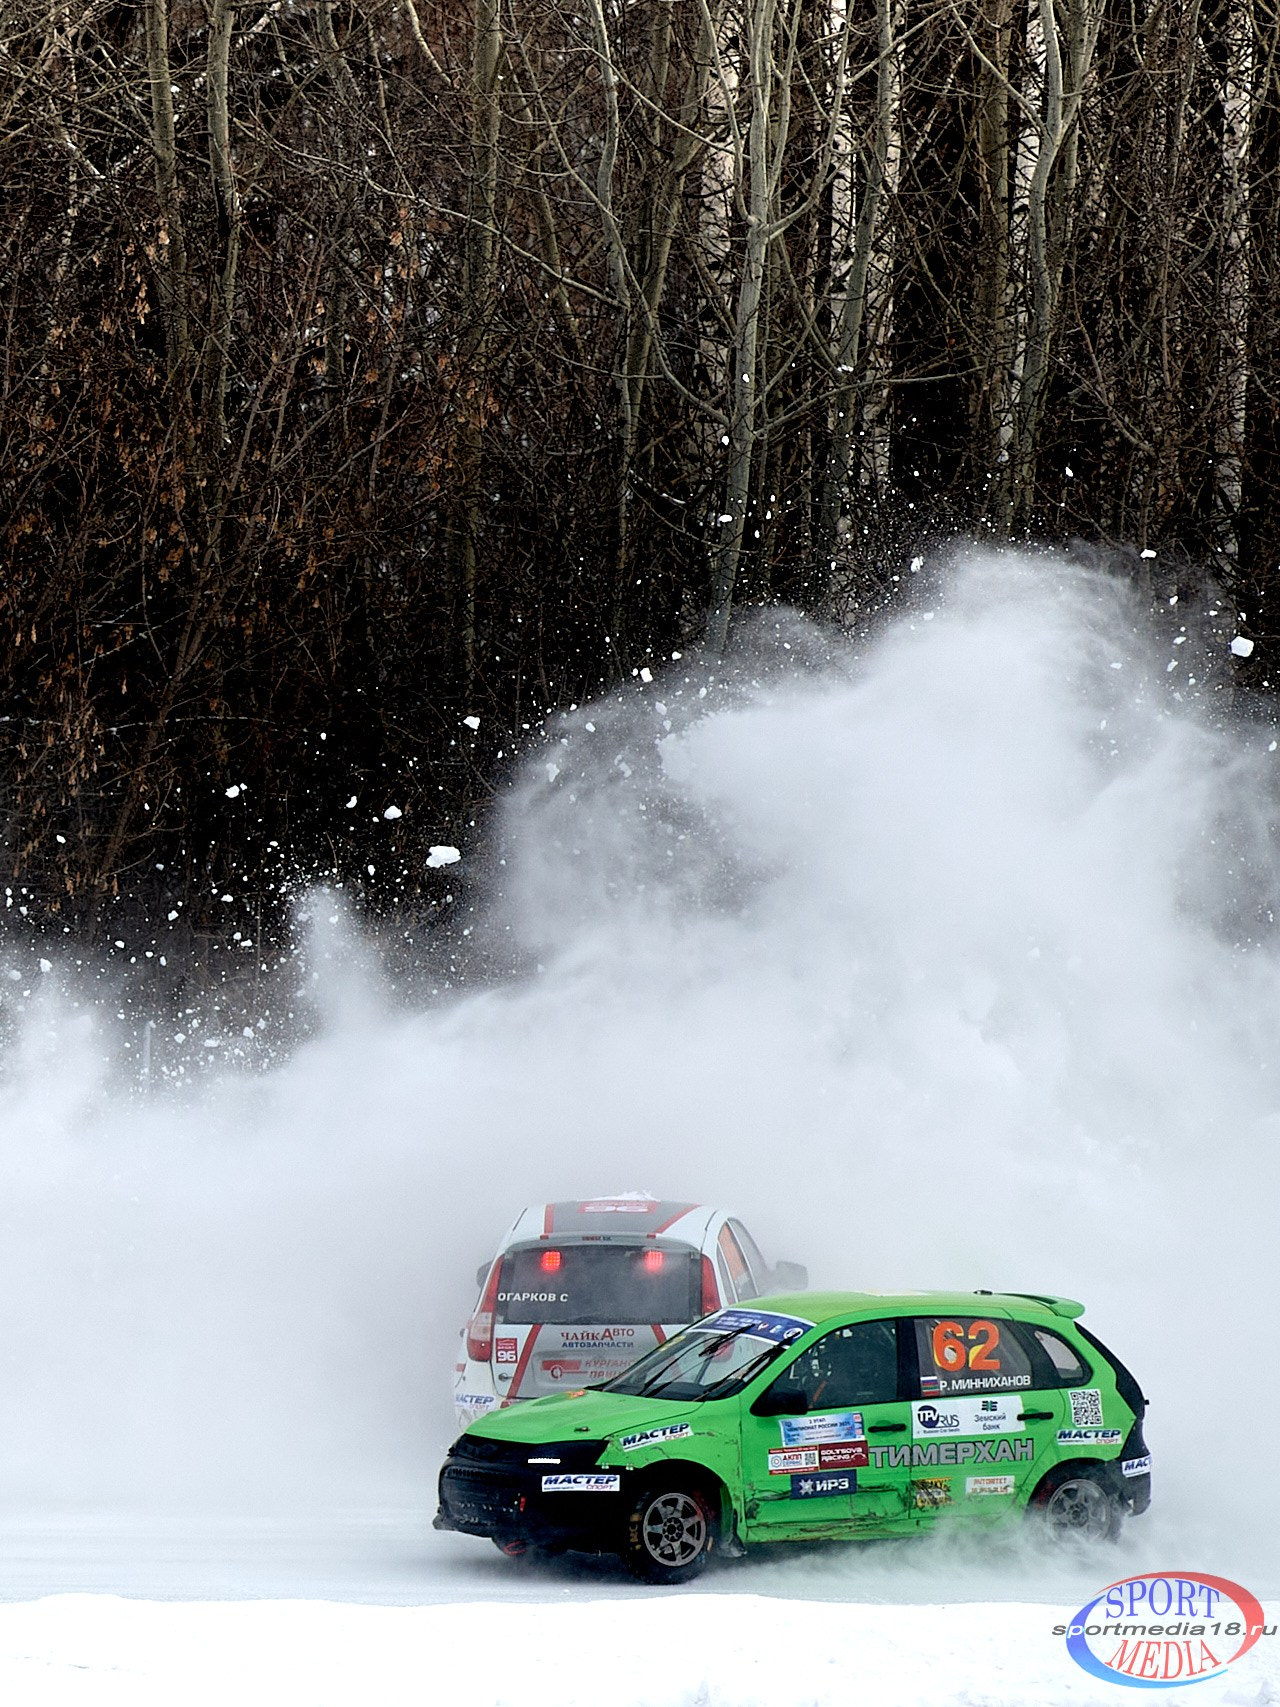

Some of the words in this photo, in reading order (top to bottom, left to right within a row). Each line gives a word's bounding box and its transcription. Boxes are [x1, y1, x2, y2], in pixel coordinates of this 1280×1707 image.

[497, 1292, 557, 1302] ОГАРКОВ
[560, 1293, 569, 1302] С
[933, 1320, 1001, 1372] 62
[497, 1350, 517, 1362] 96
[951, 1375, 1031, 1390] МИННИХАНОВ
[974, 1413, 1006, 1423] Земский
[982, 1423, 1000, 1431] банк
[622, 1423, 690, 1447] МАСТЕР
[665, 1432, 689, 1441] СПОРТ
[1058, 1430, 1121, 1439] МАСТЕР
[869, 1438, 1034, 1468] ТИМЕРХАН
[543, 1475, 618, 1485] МАСТЕР
[815, 1478, 849, 1491] ИРЗ
